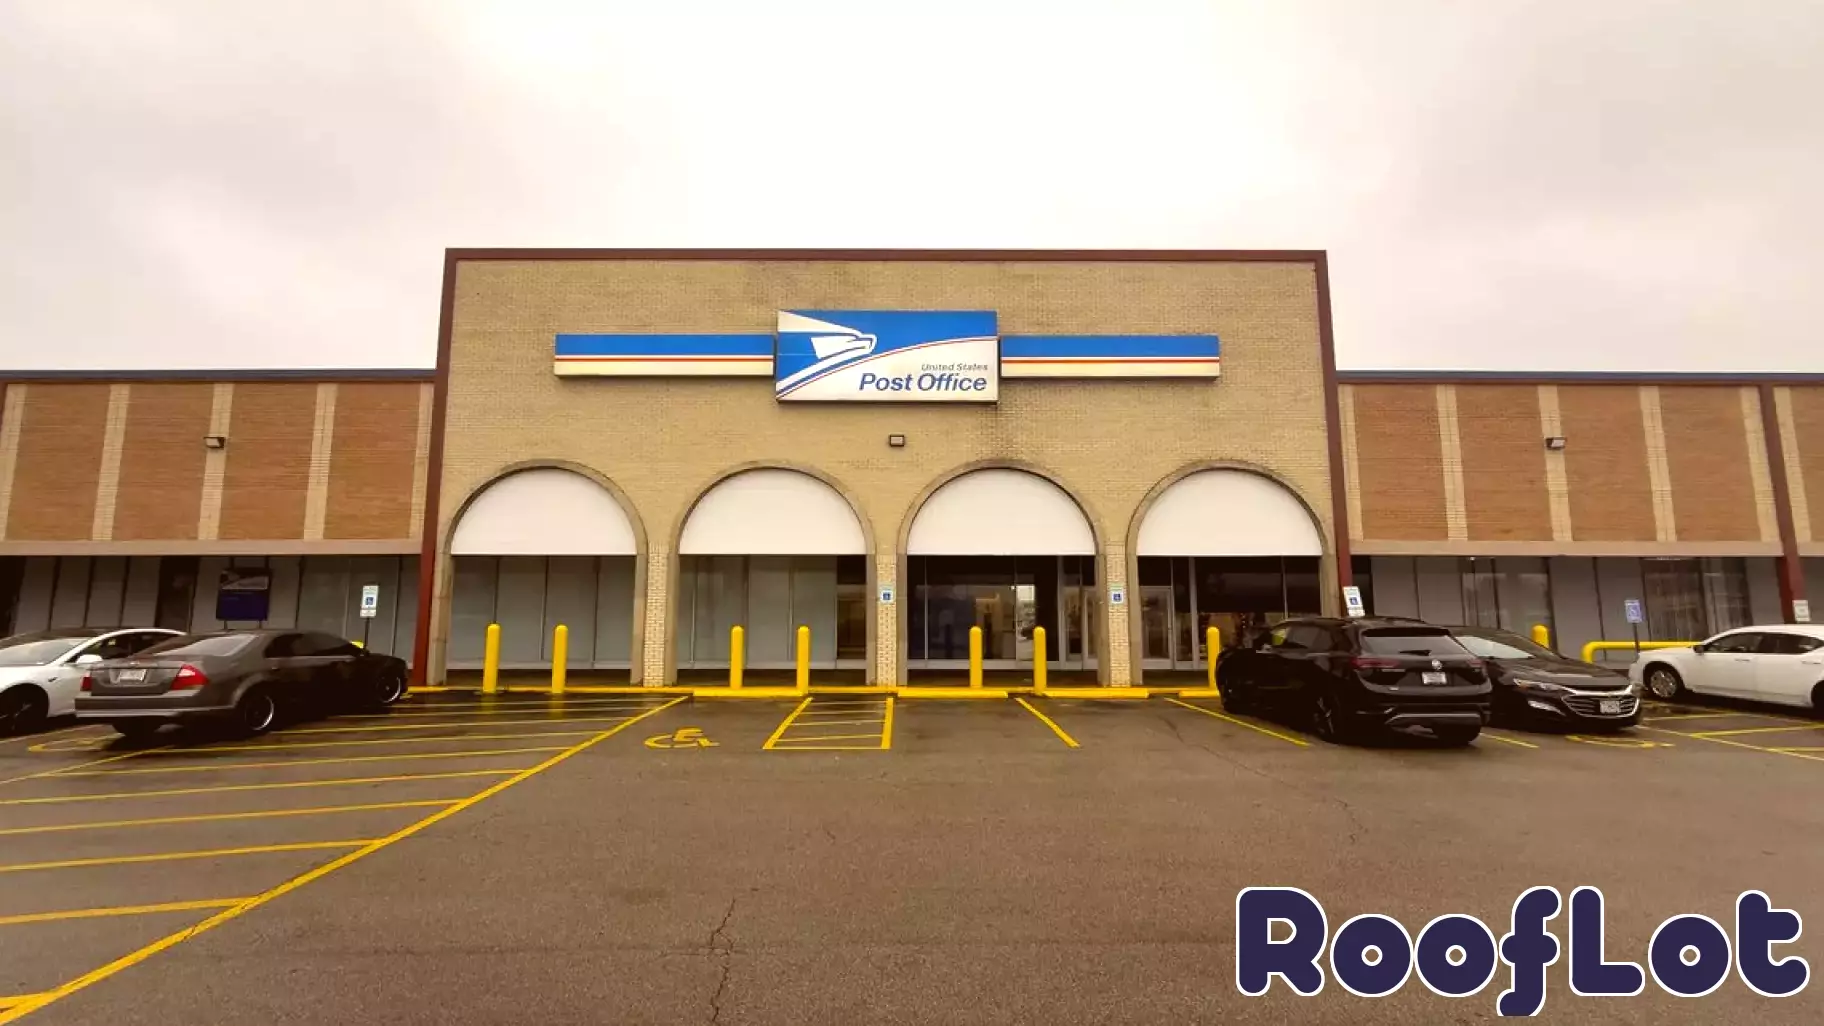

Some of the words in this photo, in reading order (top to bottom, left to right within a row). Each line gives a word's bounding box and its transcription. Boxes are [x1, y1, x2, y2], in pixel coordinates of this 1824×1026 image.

[921, 363, 955, 372] United
[956, 363, 989, 372] States
[859, 373, 913, 391] Post
[917, 372, 988, 391] Office
